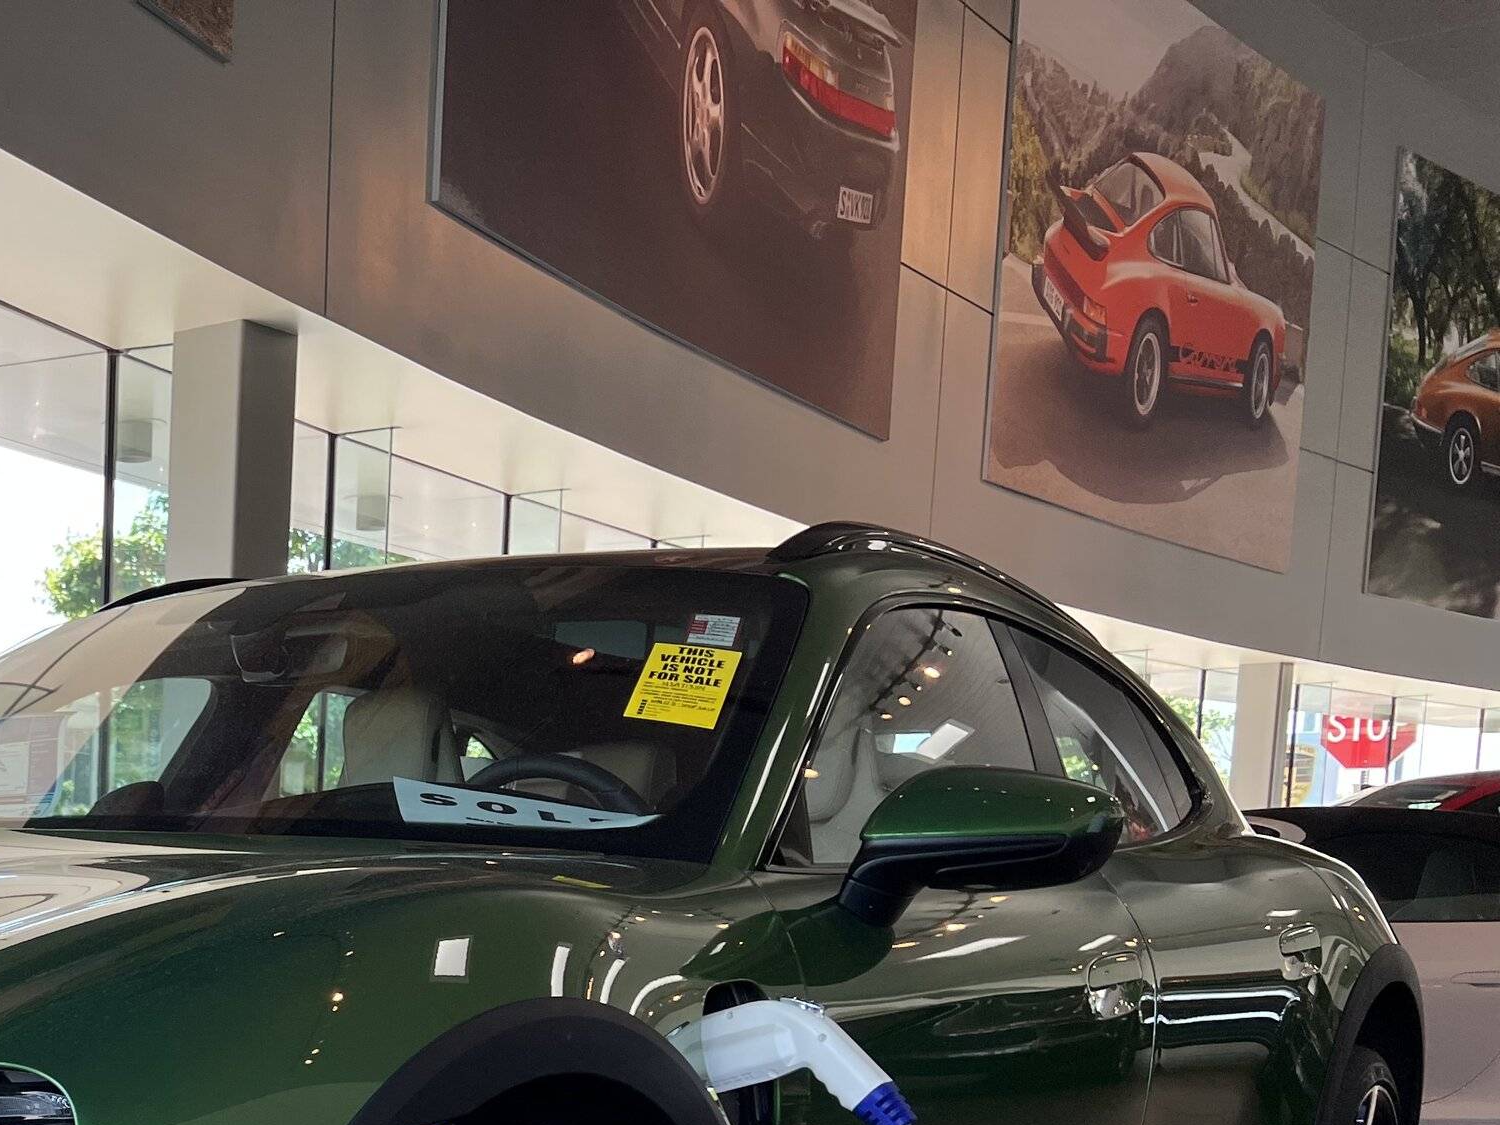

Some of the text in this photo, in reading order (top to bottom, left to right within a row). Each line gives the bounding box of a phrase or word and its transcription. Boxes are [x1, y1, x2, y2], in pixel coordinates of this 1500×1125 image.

[678, 646, 715, 658] THIS
[660, 654, 726, 669] VEHICLE
[661, 663, 717, 676] IS NOT
[648, 671, 680, 681] FOR
[683, 674, 723, 688] SALE
